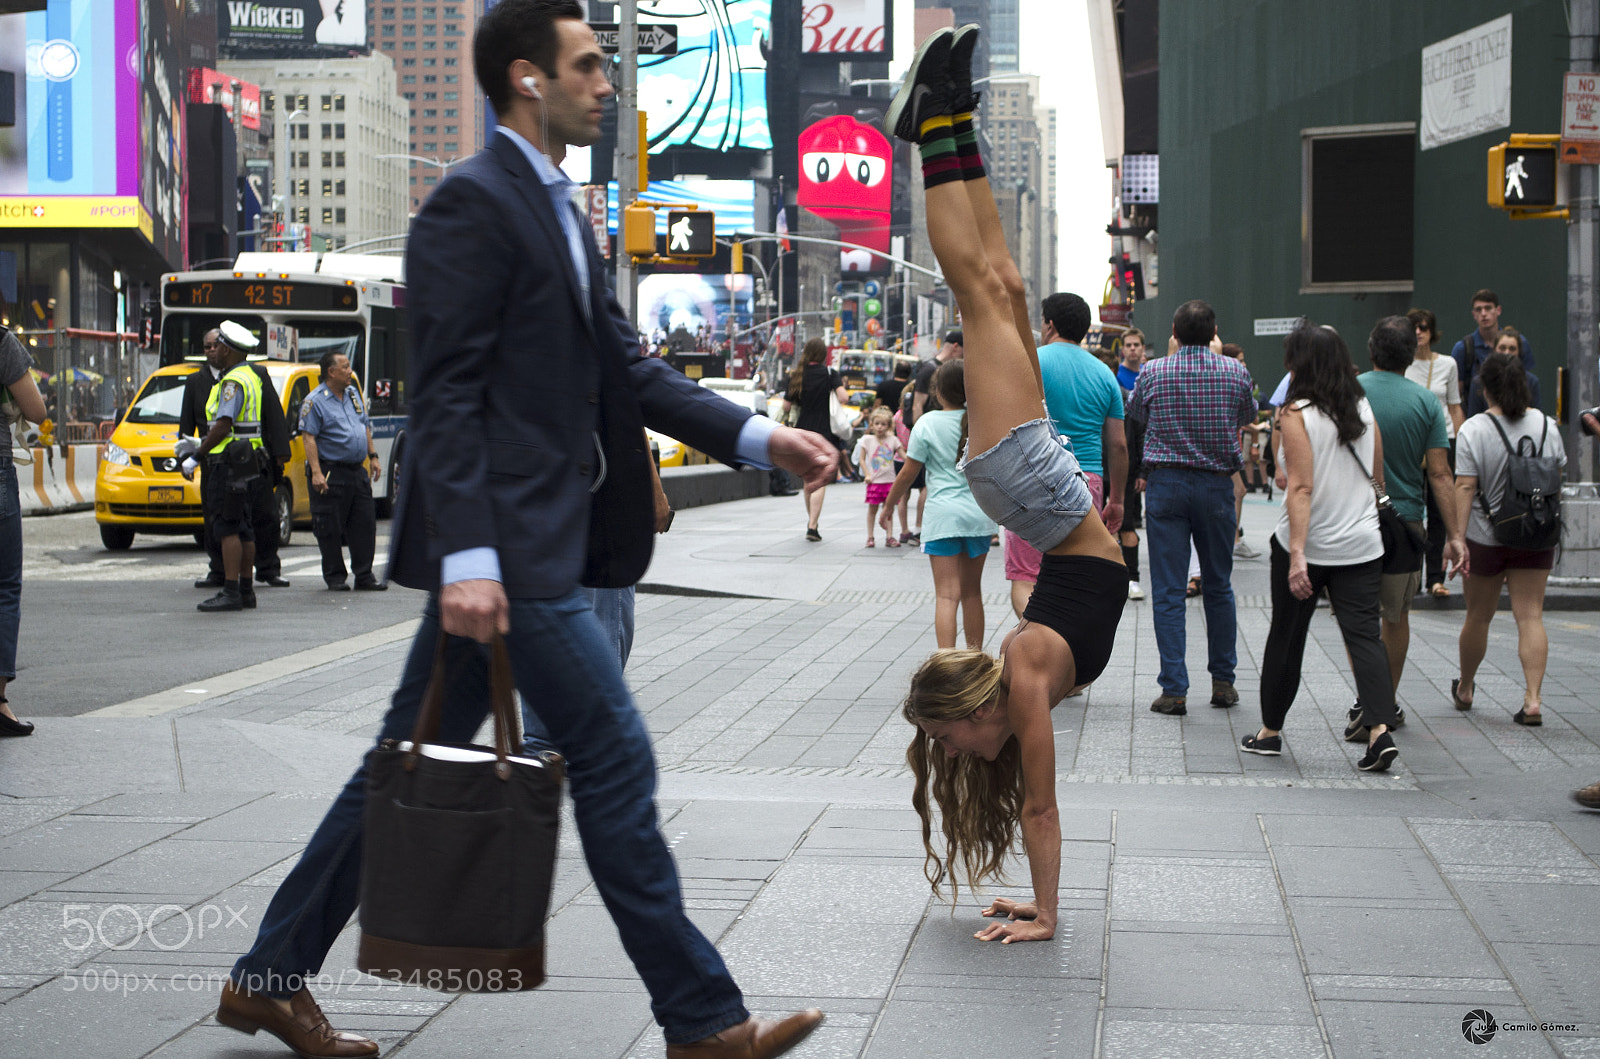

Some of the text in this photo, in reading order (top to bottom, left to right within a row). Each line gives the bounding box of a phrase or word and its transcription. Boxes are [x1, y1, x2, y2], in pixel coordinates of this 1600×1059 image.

[593, 32, 619, 45] ONE
[1578, 79, 1596, 93] NO
[1576, 103, 1593, 112] ANY
[1575, 111, 1592, 121] TIME
[0, 203, 33, 217] tch
[245, 285, 265, 305] 42
[272, 285, 294, 306] ST
